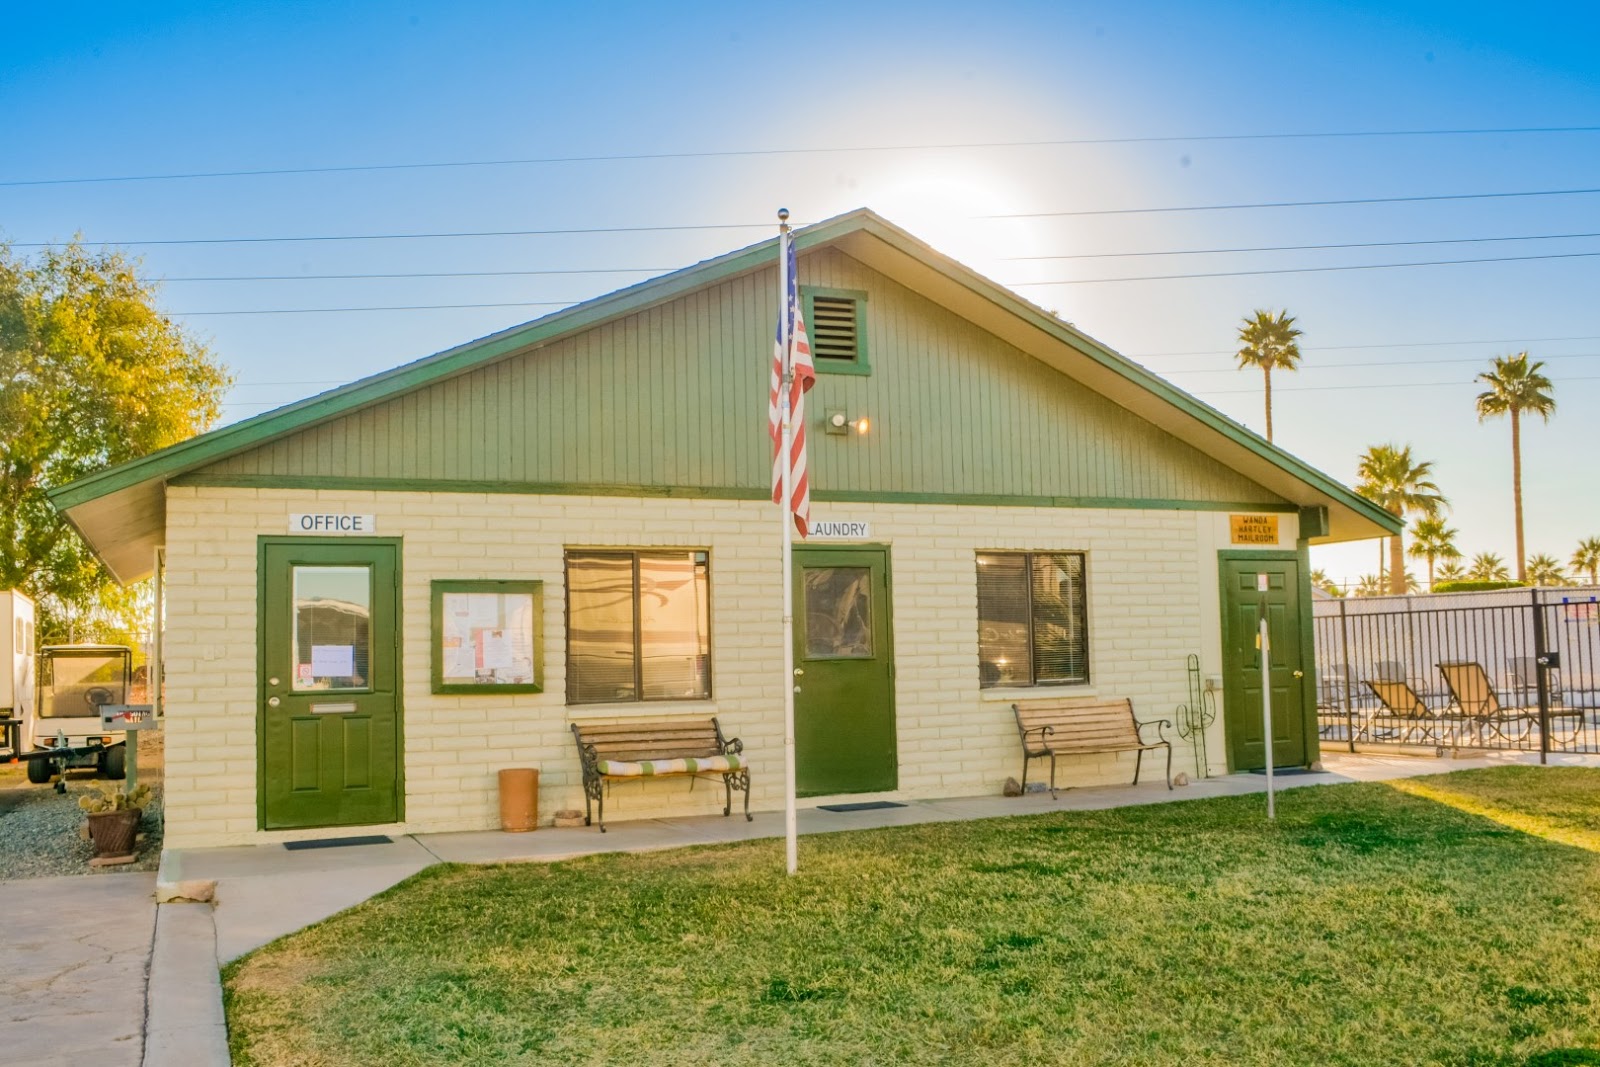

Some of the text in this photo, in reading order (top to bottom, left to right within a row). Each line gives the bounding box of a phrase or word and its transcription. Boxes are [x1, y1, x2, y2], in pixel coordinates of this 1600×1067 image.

[301, 515, 363, 531] OFFICE
[1243, 516, 1268, 525] WANDA
[1238, 525, 1272, 534] HARTLEY
[1237, 534, 1274, 543] MAILROOM
